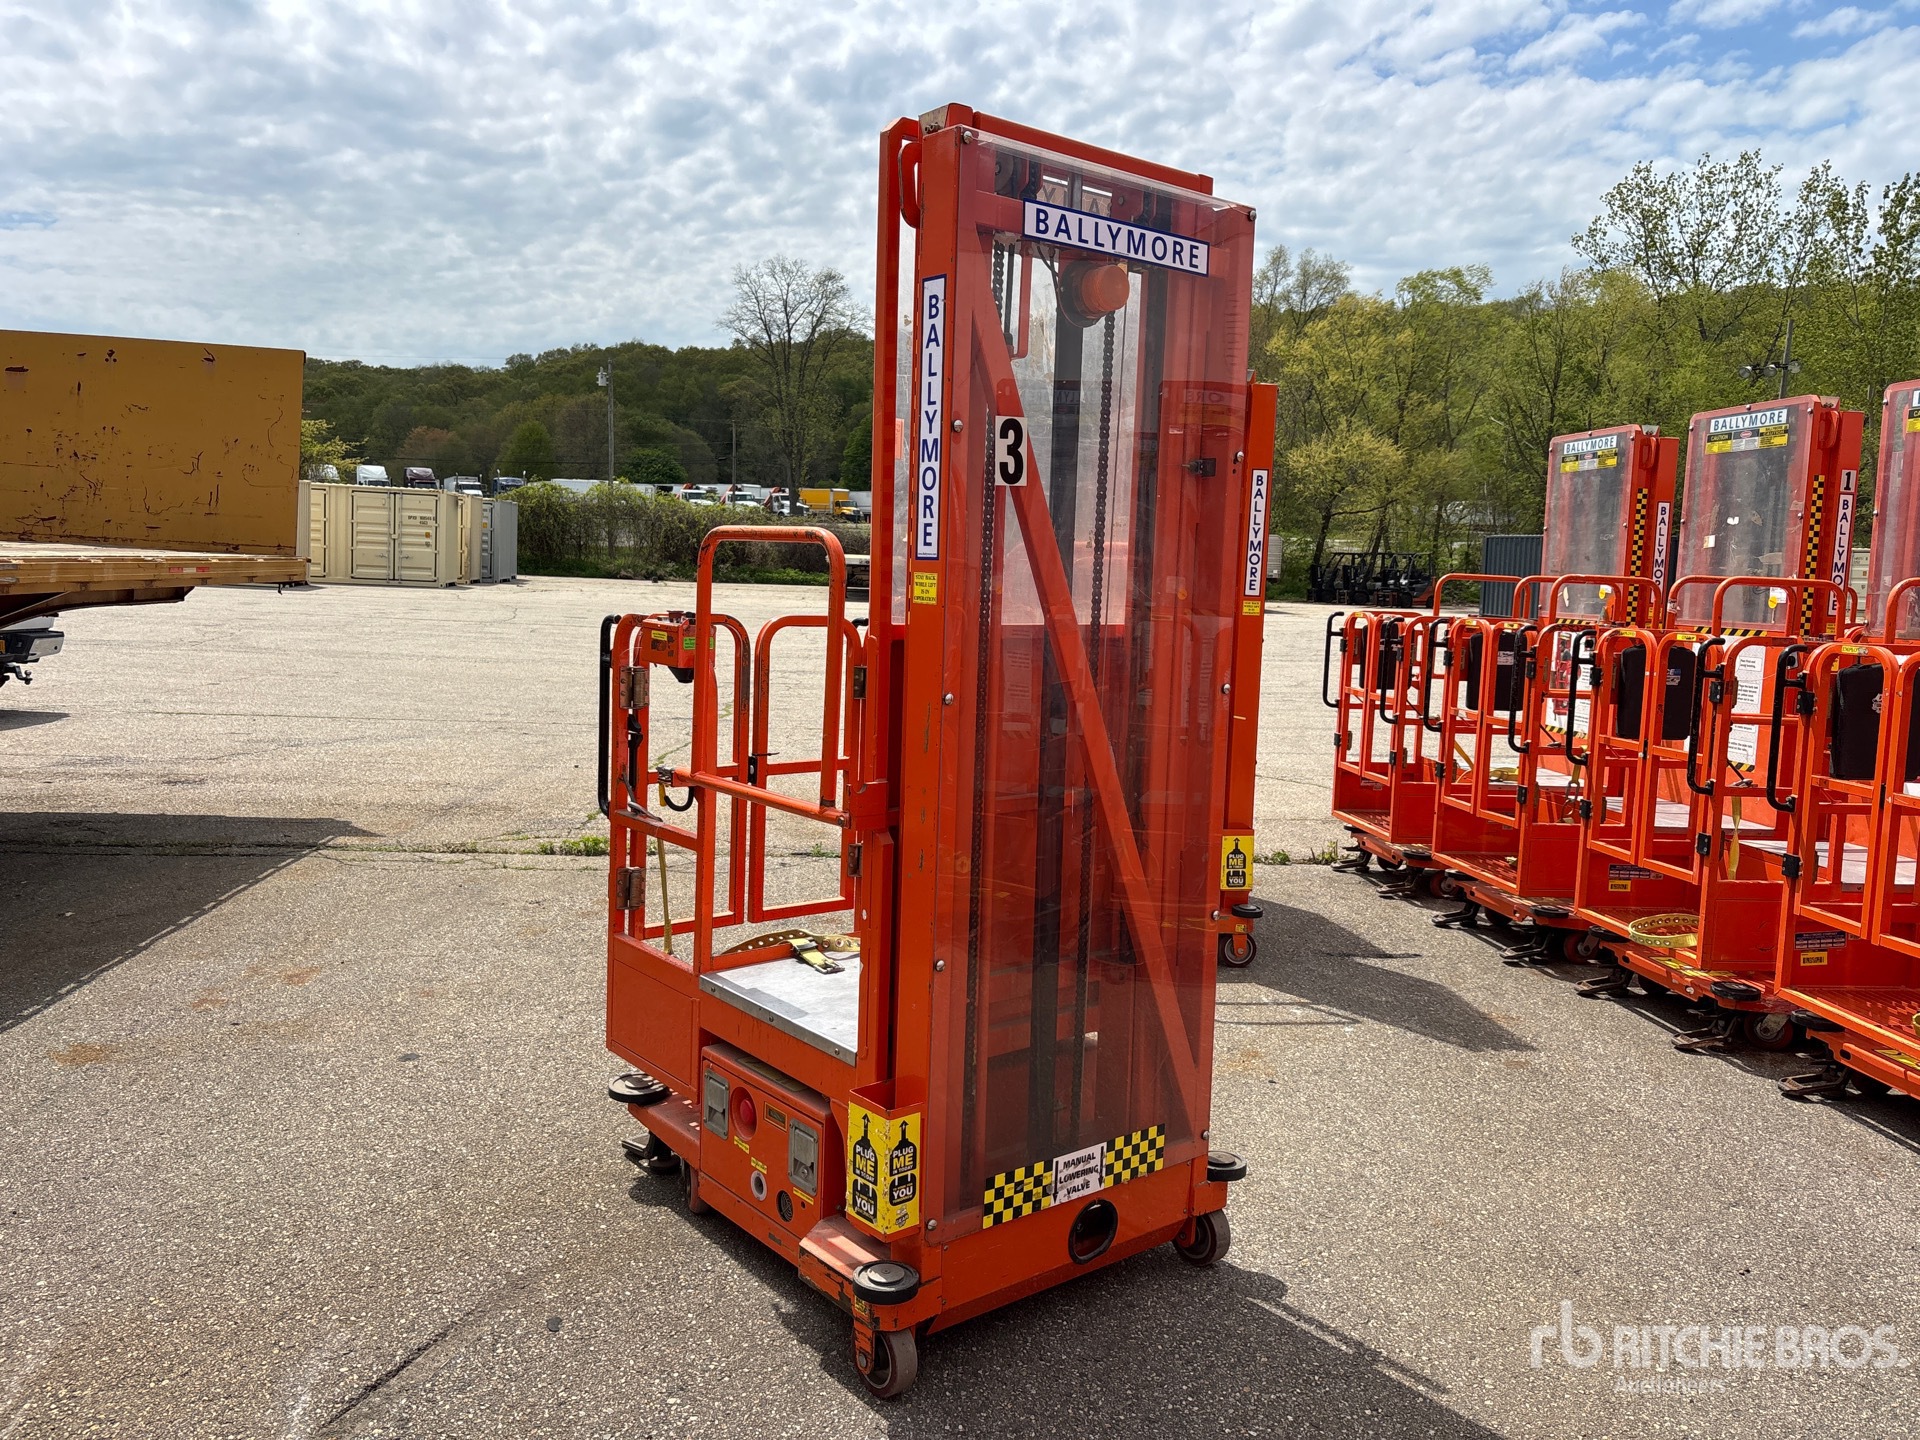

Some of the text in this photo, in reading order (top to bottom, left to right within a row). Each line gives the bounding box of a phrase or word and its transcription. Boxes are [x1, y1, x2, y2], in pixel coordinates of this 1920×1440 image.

[1035, 207, 1200, 269] BALLYMORE
[921, 293, 940, 547] BALLYMORE
[1713, 411, 1784, 431] BALLYMORE
[999, 417, 1024, 485] 3
[1565, 437, 1614, 453] BALLYMORE
[1843, 471, 1852, 491] 1
[1249, 474, 1264, 591] BALLYMORE
[1229, 858, 1244, 866] ME
[855, 1144, 875, 1162] PLUG
[892, 1145, 914, 1159] PLUG
[892, 1153, 914, 1170] ME
[1063, 1152, 1097, 1170] MANUAL
[855, 1154, 875, 1178] ME
[898, 1165, 914, 1174] TODAY
[1059, 1164, 1099, 1185] LOWERING
[892, 1185, 913, 1200] YOU
[1066, 1181, 1091, 1196] VALVE
[855, 1195, 874, 1215] YOU
